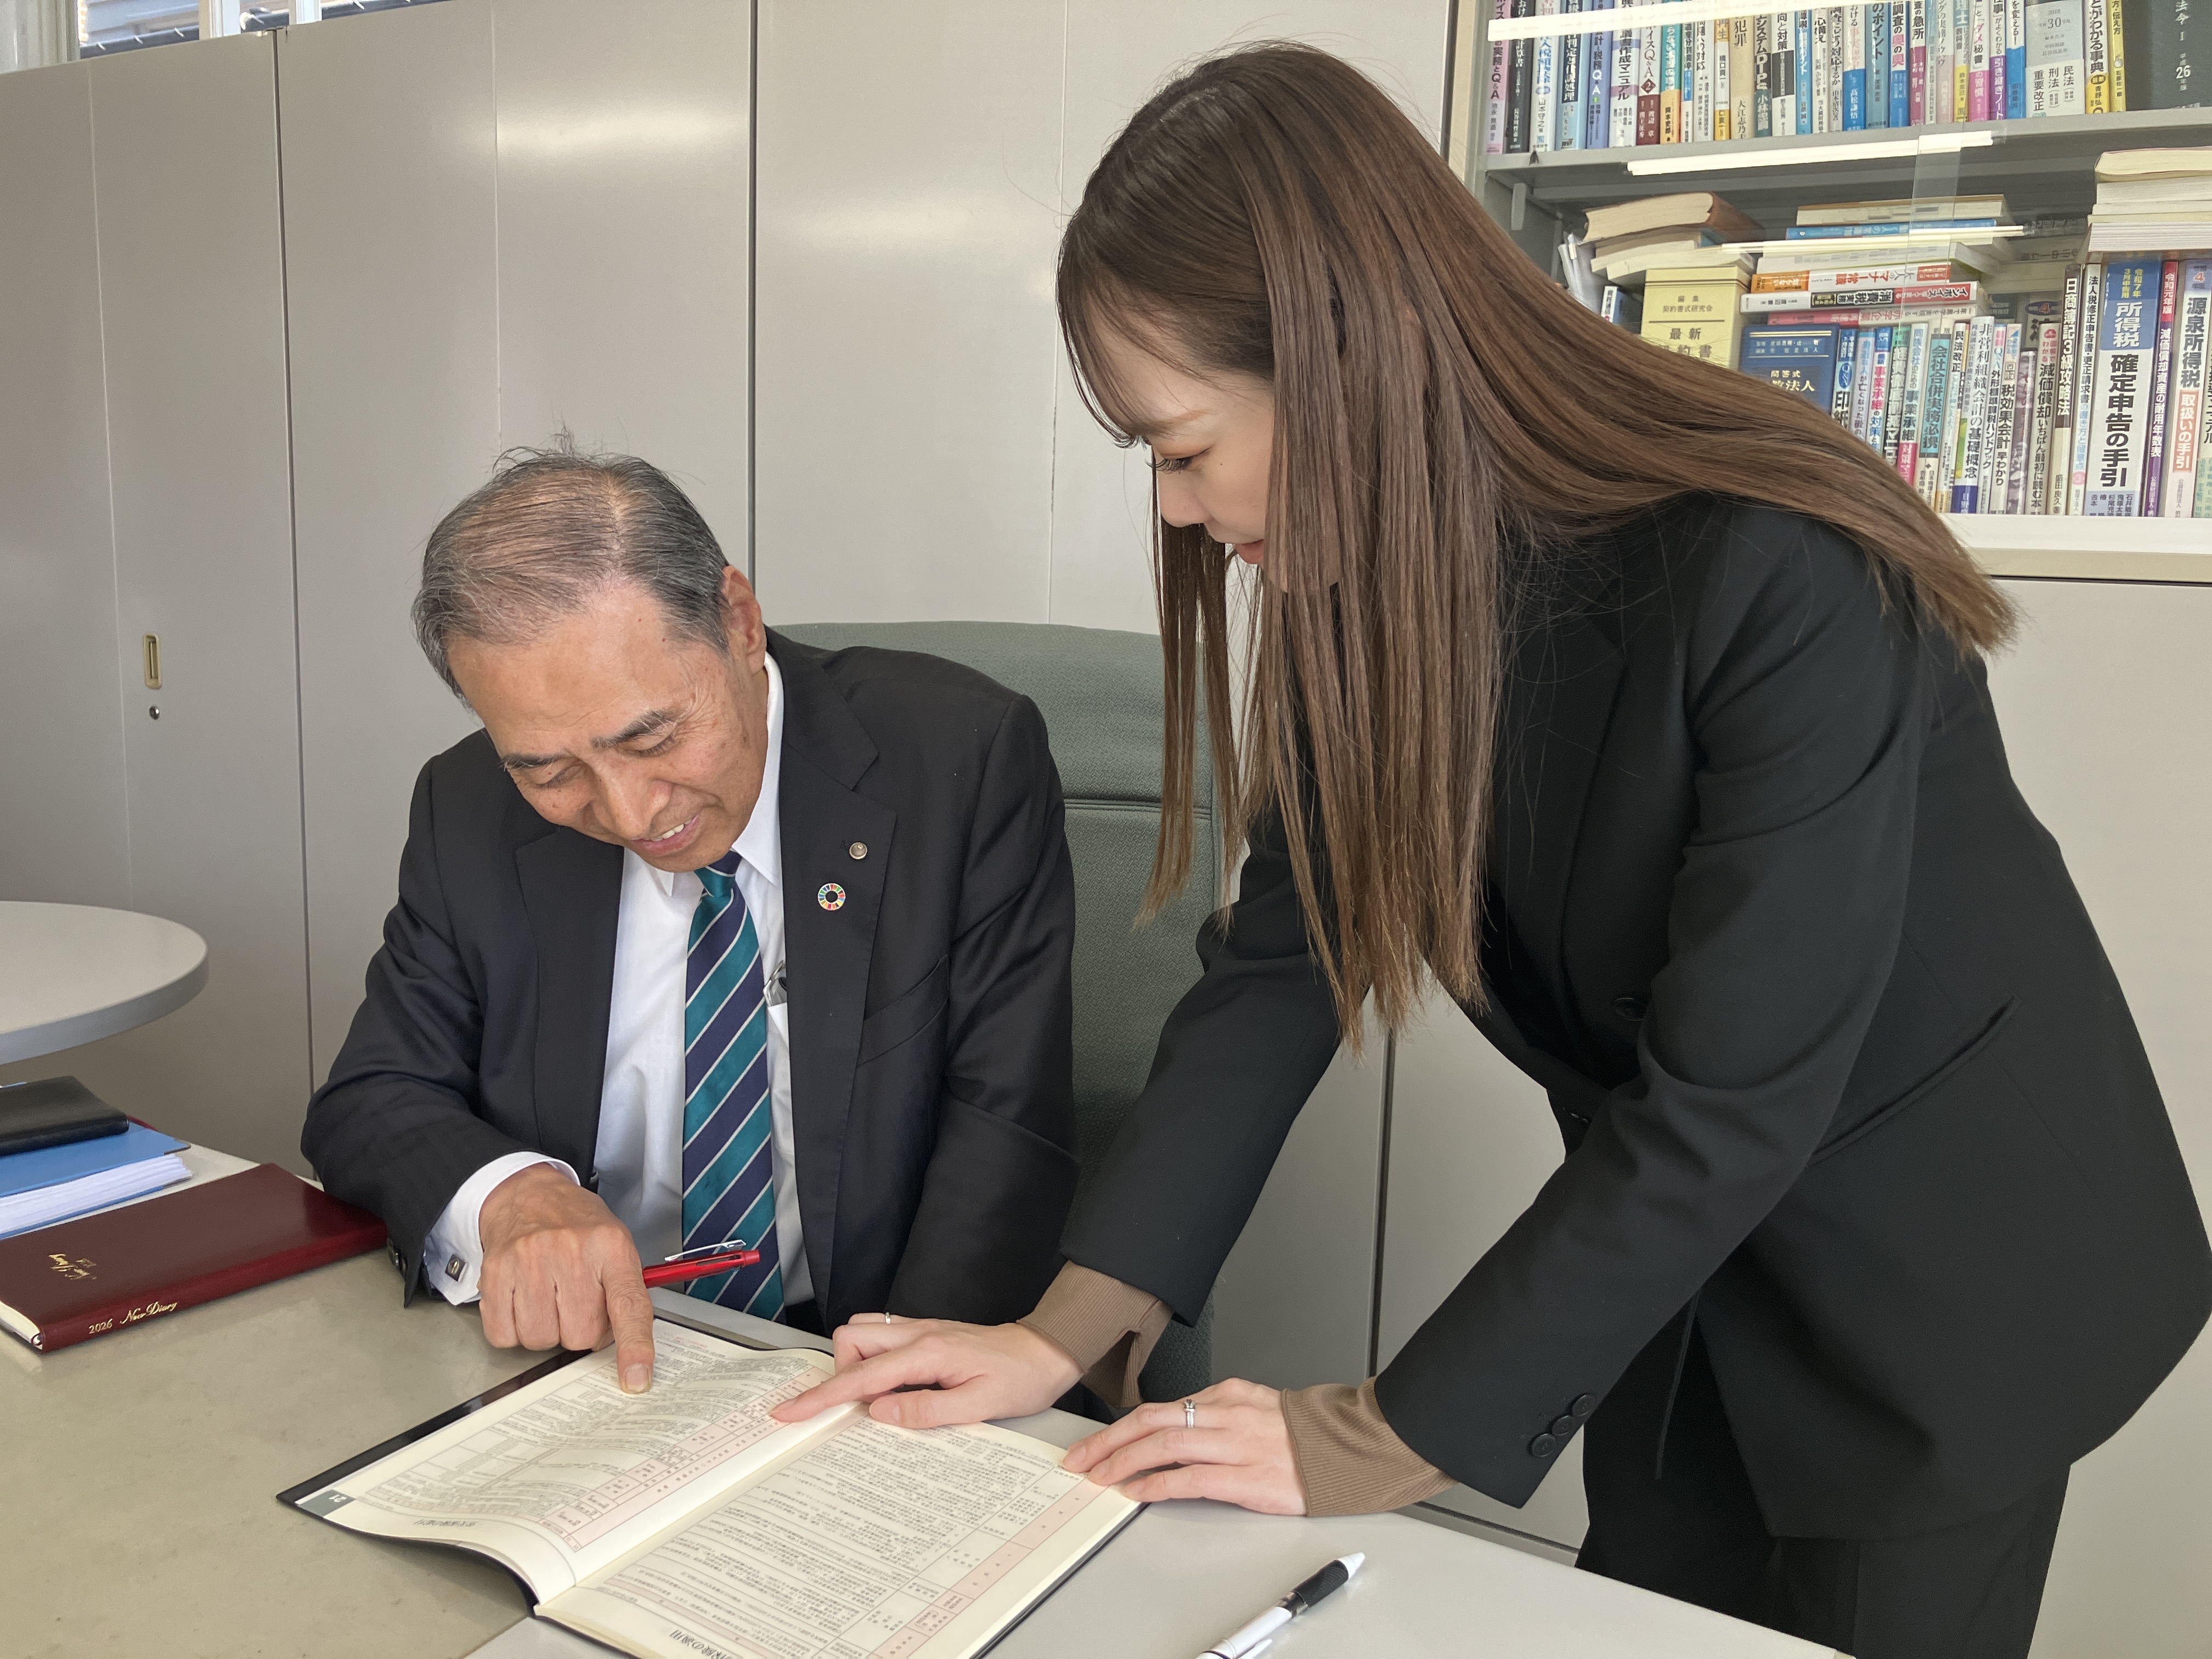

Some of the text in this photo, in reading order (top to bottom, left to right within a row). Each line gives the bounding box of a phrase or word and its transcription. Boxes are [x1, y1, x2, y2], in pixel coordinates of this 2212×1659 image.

[1872, 3, 1884, 59] のポイント
[2174, 0, 2190, 25] 法令
[1994, 58, 2004, 120] 引き継ぎノート
[2033, 69, 2045, 111] 重要改正
[2048, 67, 2059, 89] 刑法
[2063, 65, 2074, 86] 民法
[1928, 286, 1968, 298] インボイス
[2132, 268, 2143, 298] 令和7年
[2162, 273, 2175, 314] 令和元年版
[2194, 272, 2205, 283] 4
[1670, 327, 1701, 340] 最新
[2113, 301, 2143, 348] 所得税
[2180, 297, 2208, 388] 源泉所得税
[1951, 331, 1964, 372] 民法改正
[2057, 278, 2078, 416] 日商簿記3級攻略法
[1770, 370, 1801, 379] 問答式
[2151, 328, 2171, 458] 減価償却資産の耐用年数表
[1922, 345, 1948, 449] 会社合併実務必携
[1964, 324, 1991, 478] 非営利組織会計の基礎概念
[1996, 384, 2016, 449] 税効果会計
[2100, 354, 2139, 487] 確定申告の手引
[2175, 394, 2196, 469] 取扱いの手引
[1995, 452, 2008, 486] 早わかり
[88, 1318, 113, 1334] 2026
[145, 1301, 177, 1316] Diary
